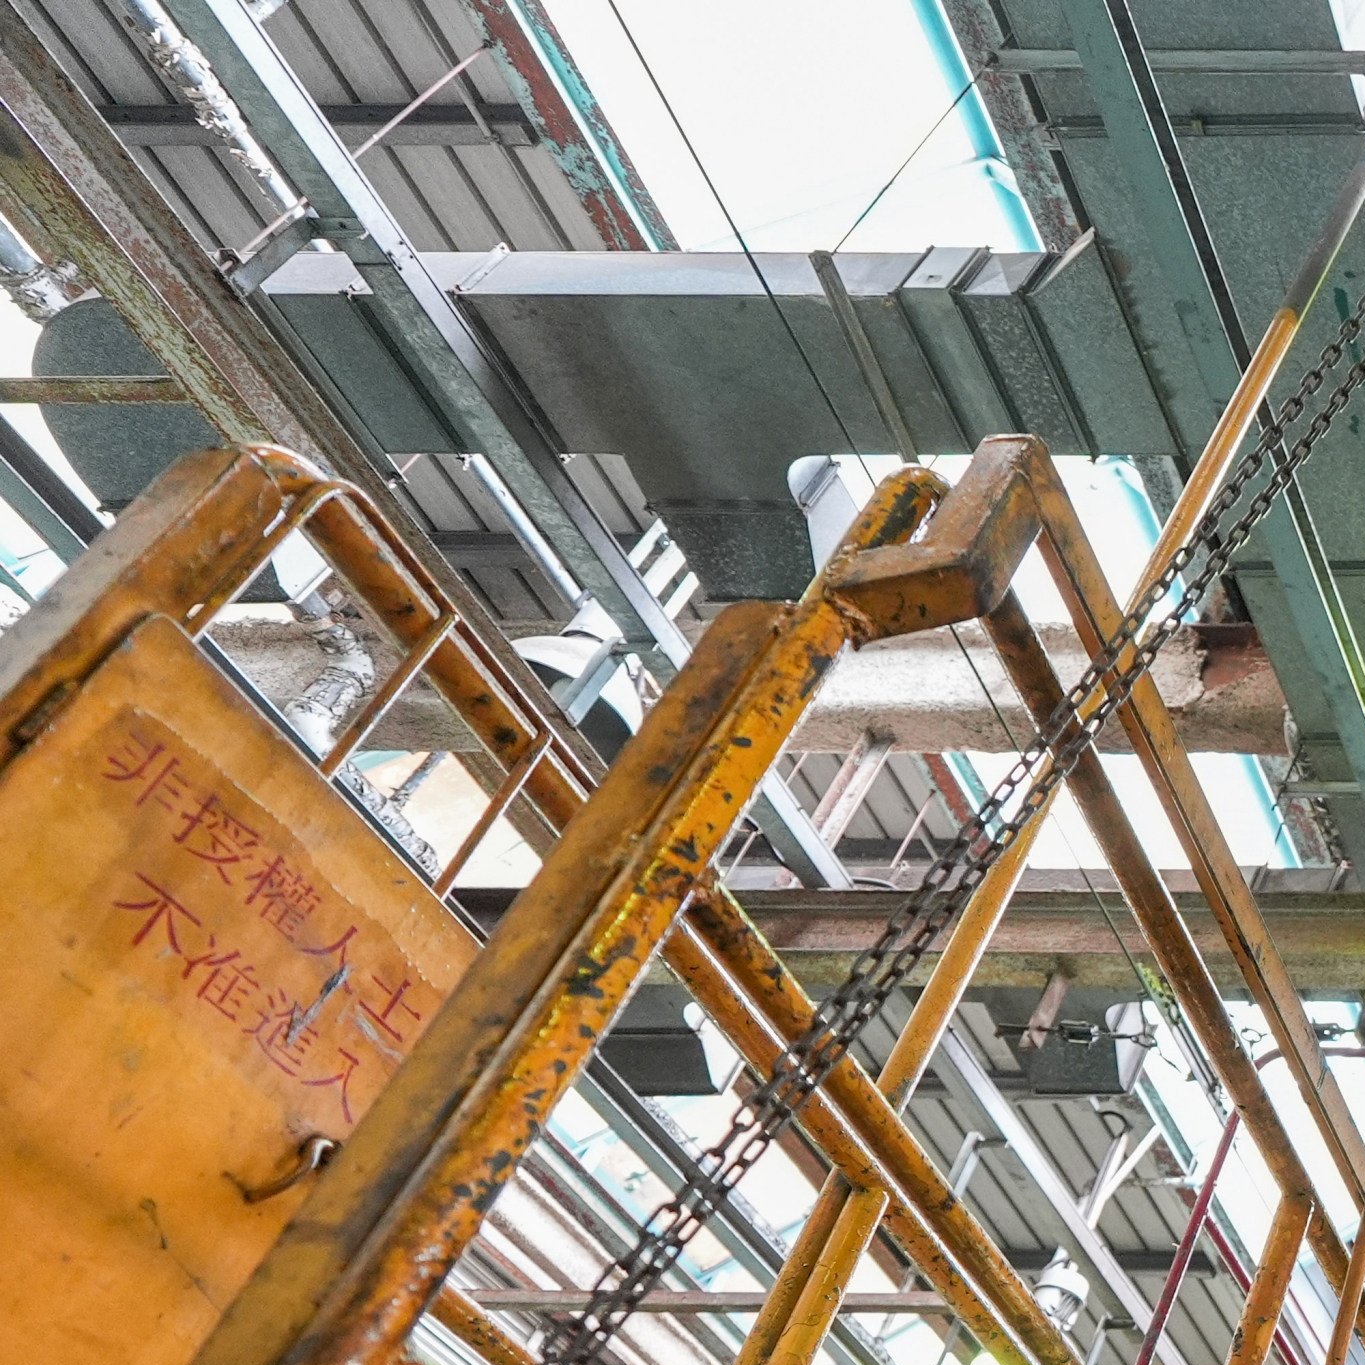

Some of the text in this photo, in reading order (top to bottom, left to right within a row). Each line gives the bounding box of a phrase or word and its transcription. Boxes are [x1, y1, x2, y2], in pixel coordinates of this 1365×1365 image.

[102, 731, 422, 1042] 非授權人士
[115, 872, 361, 1123] 不准進入
